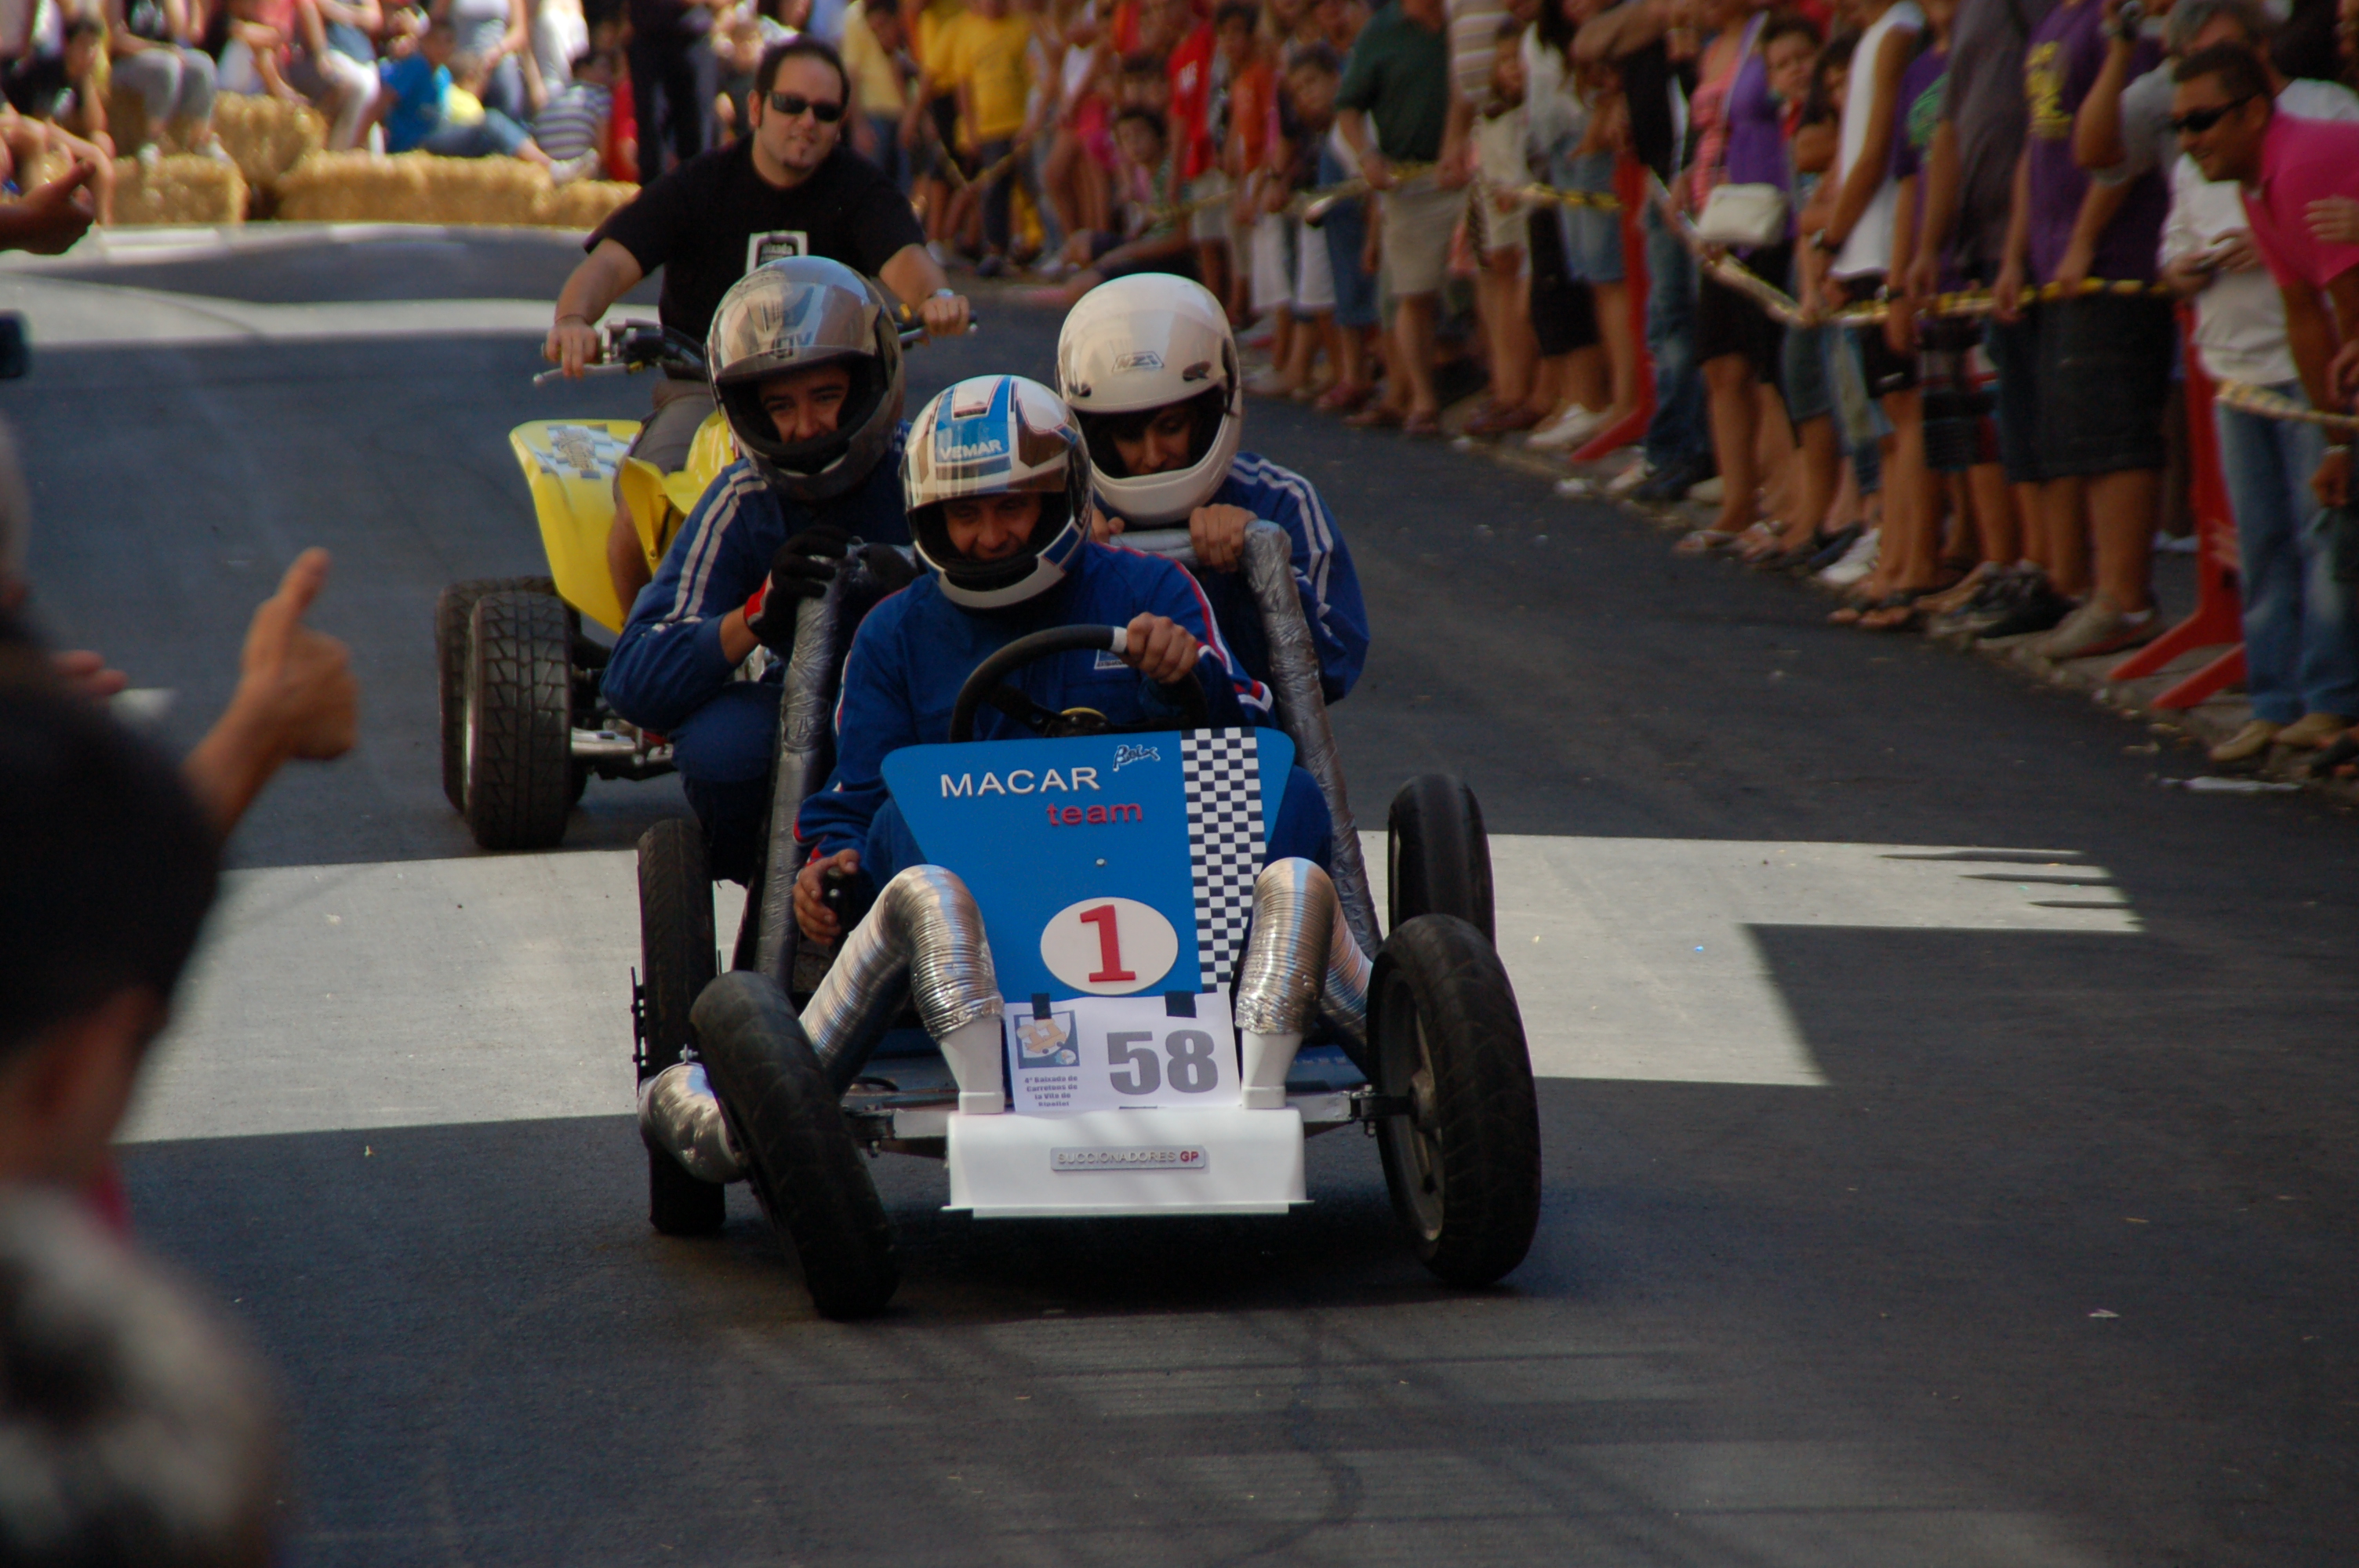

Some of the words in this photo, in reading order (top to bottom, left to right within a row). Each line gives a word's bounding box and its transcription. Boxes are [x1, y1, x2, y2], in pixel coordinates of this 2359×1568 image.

[940, 439, 1002, 460] VEMAR
[940, 766, 1100, 798] MACAR
[1046, 802, 1143, 826] team
[1080, 904, 1136, 982] 1
[1107, 1029, 1219, 1096] 58
[1059, 1150, 1176, 1164] SUCCIONADORES
[1180, 1150, 1199, 1163] GP
